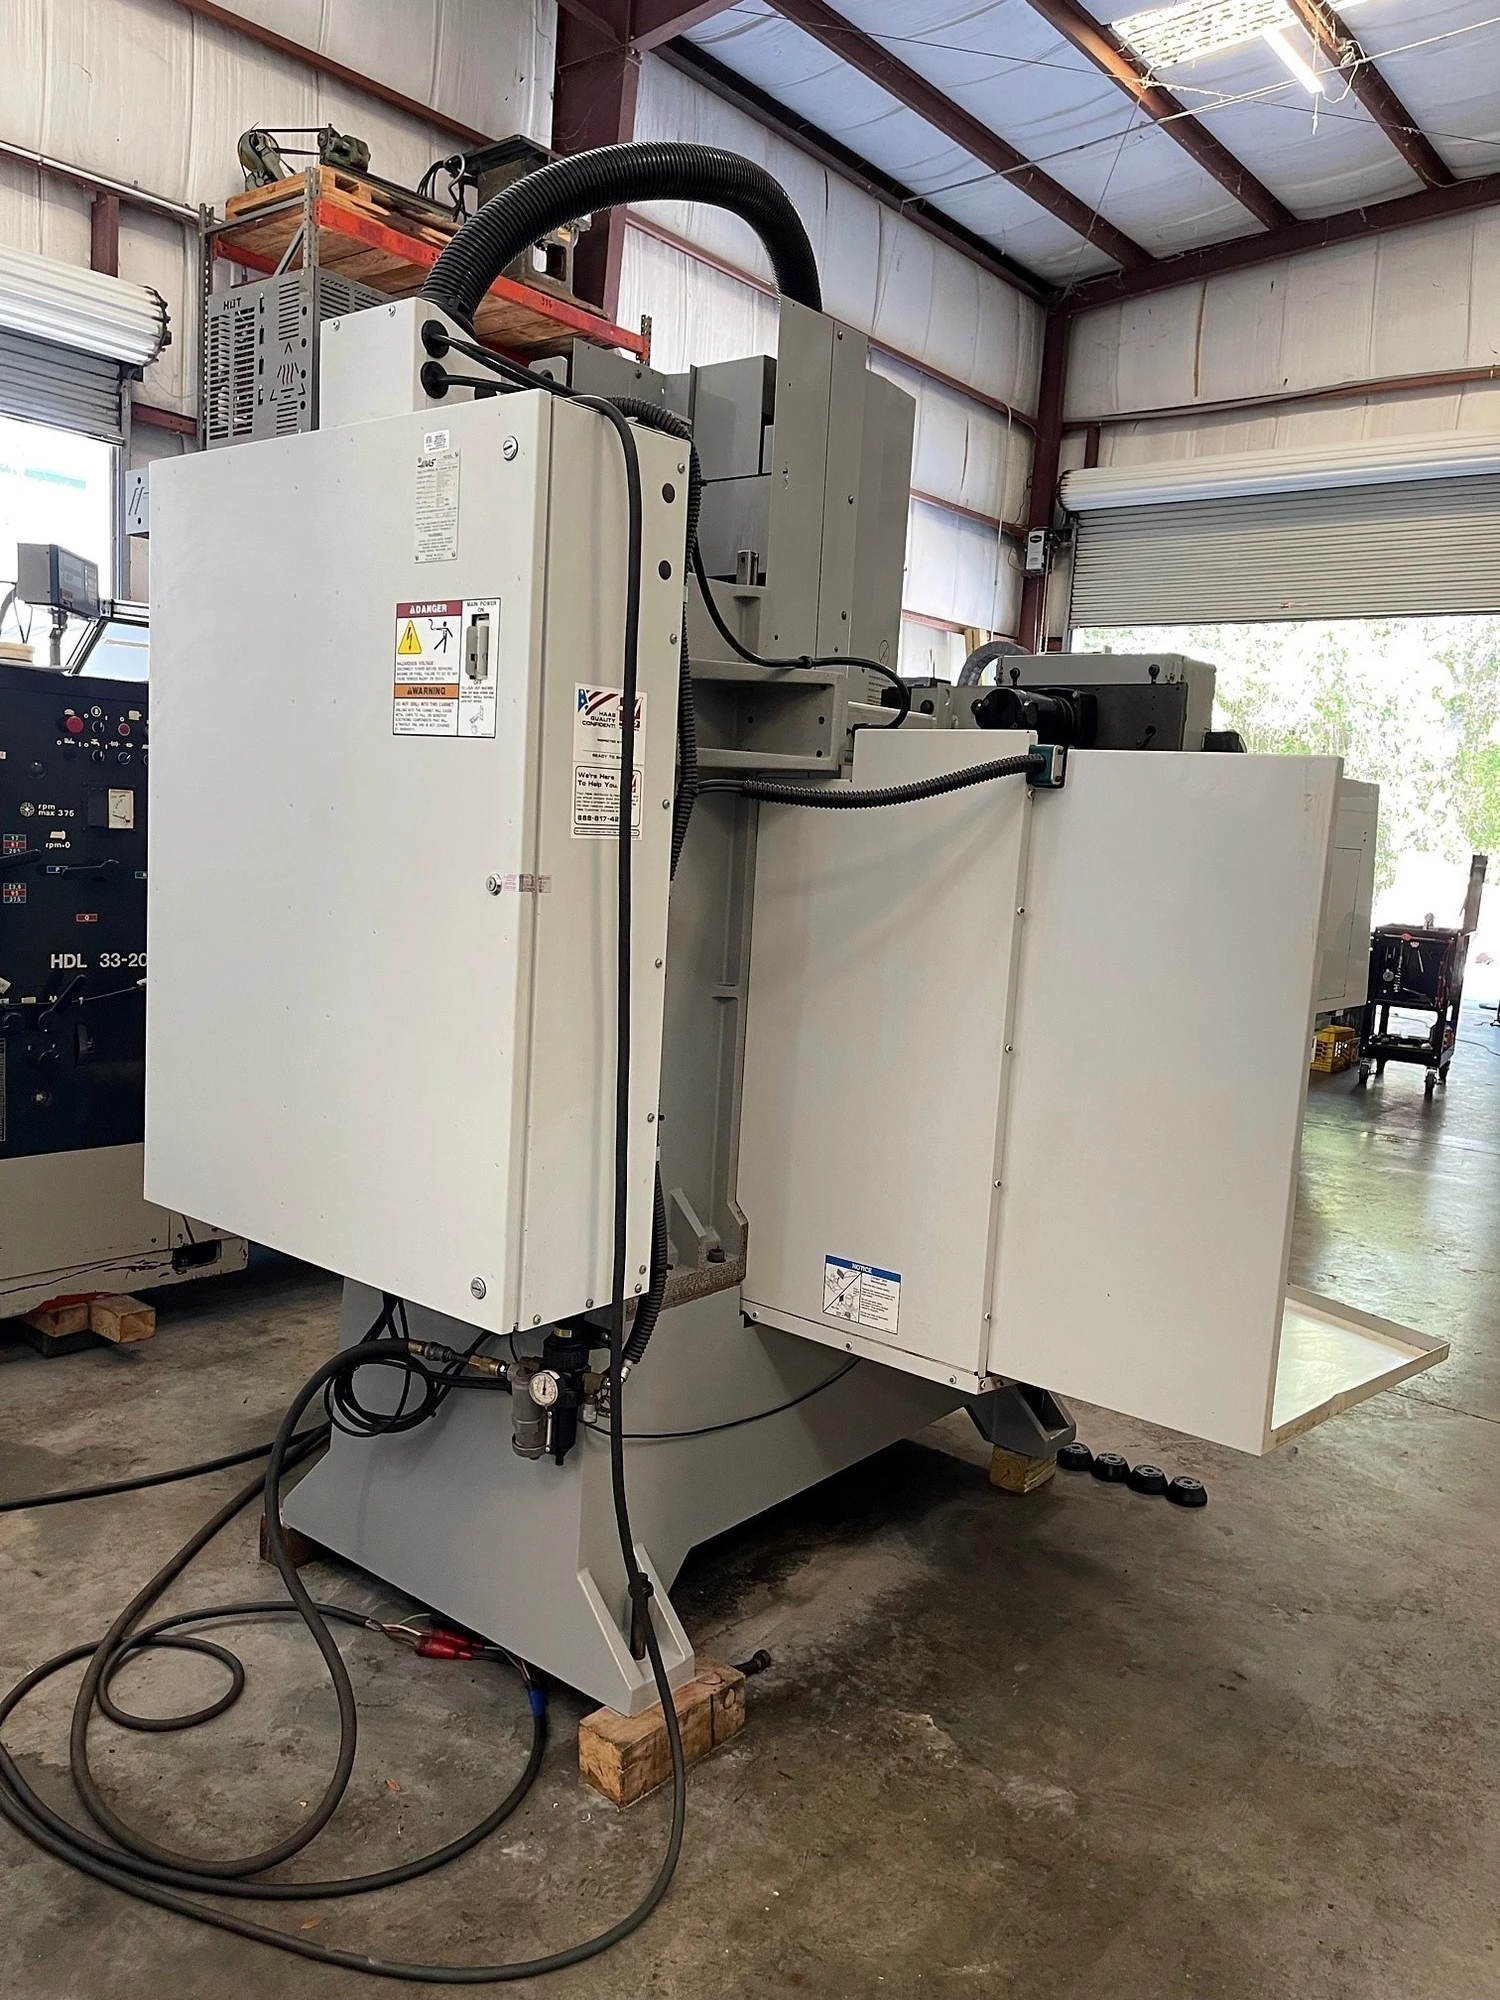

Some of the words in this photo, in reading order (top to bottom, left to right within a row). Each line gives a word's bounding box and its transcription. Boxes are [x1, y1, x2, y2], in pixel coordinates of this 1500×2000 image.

[416, 604, 447, 614] DANGER
[50, 954, 87, 969] HDL
[100, 953, 148, 967] 33-20
[852, 1264, 872, 1274] NOTICE
